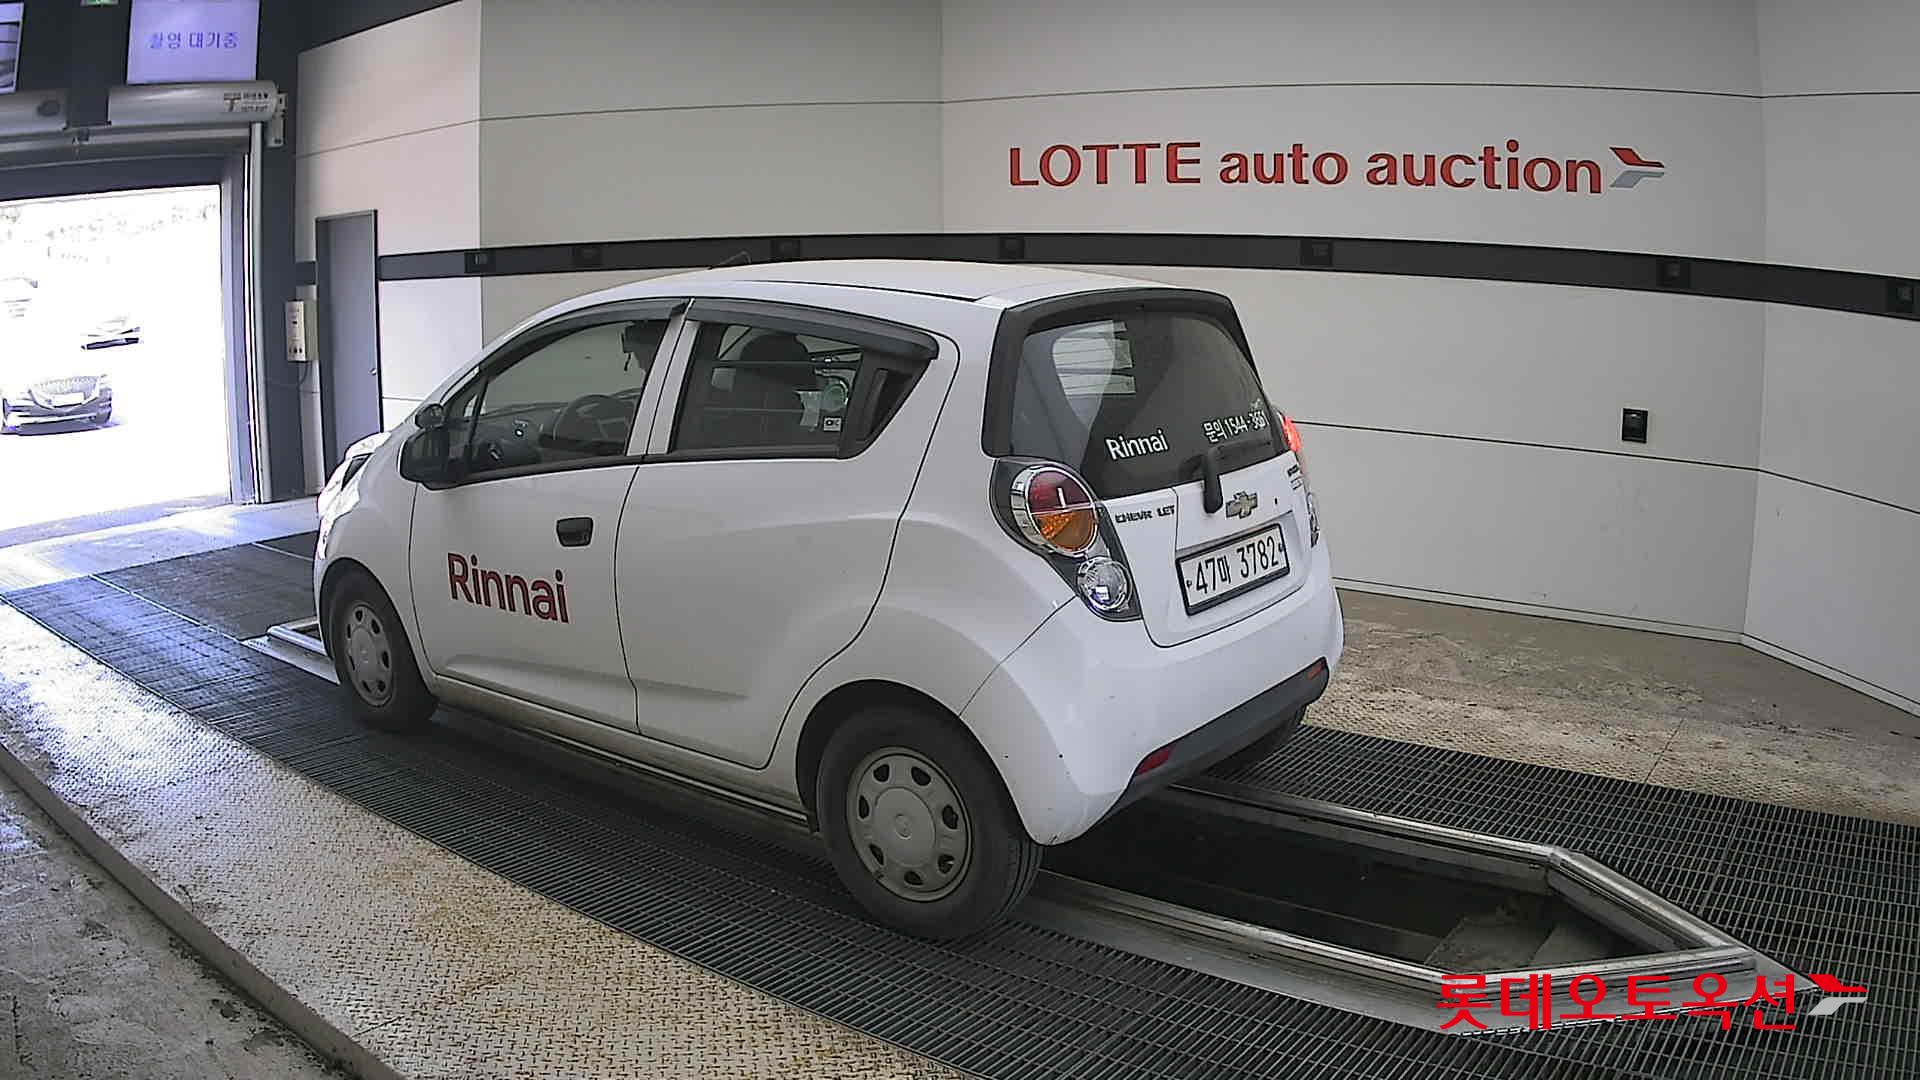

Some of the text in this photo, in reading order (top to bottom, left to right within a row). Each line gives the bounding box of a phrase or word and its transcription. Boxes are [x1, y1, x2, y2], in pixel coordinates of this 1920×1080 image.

[189, 32, 239, 49] 대기중
[1009, 140, 1602, 195] LOTTE auto auction
[1105, 429, 1169, 461] Rinnai
[1203, 418, 1228, 443] 문의
[1236, 535, 1279, 578] 3782
[447, 552, 570, 624] Rinnai
